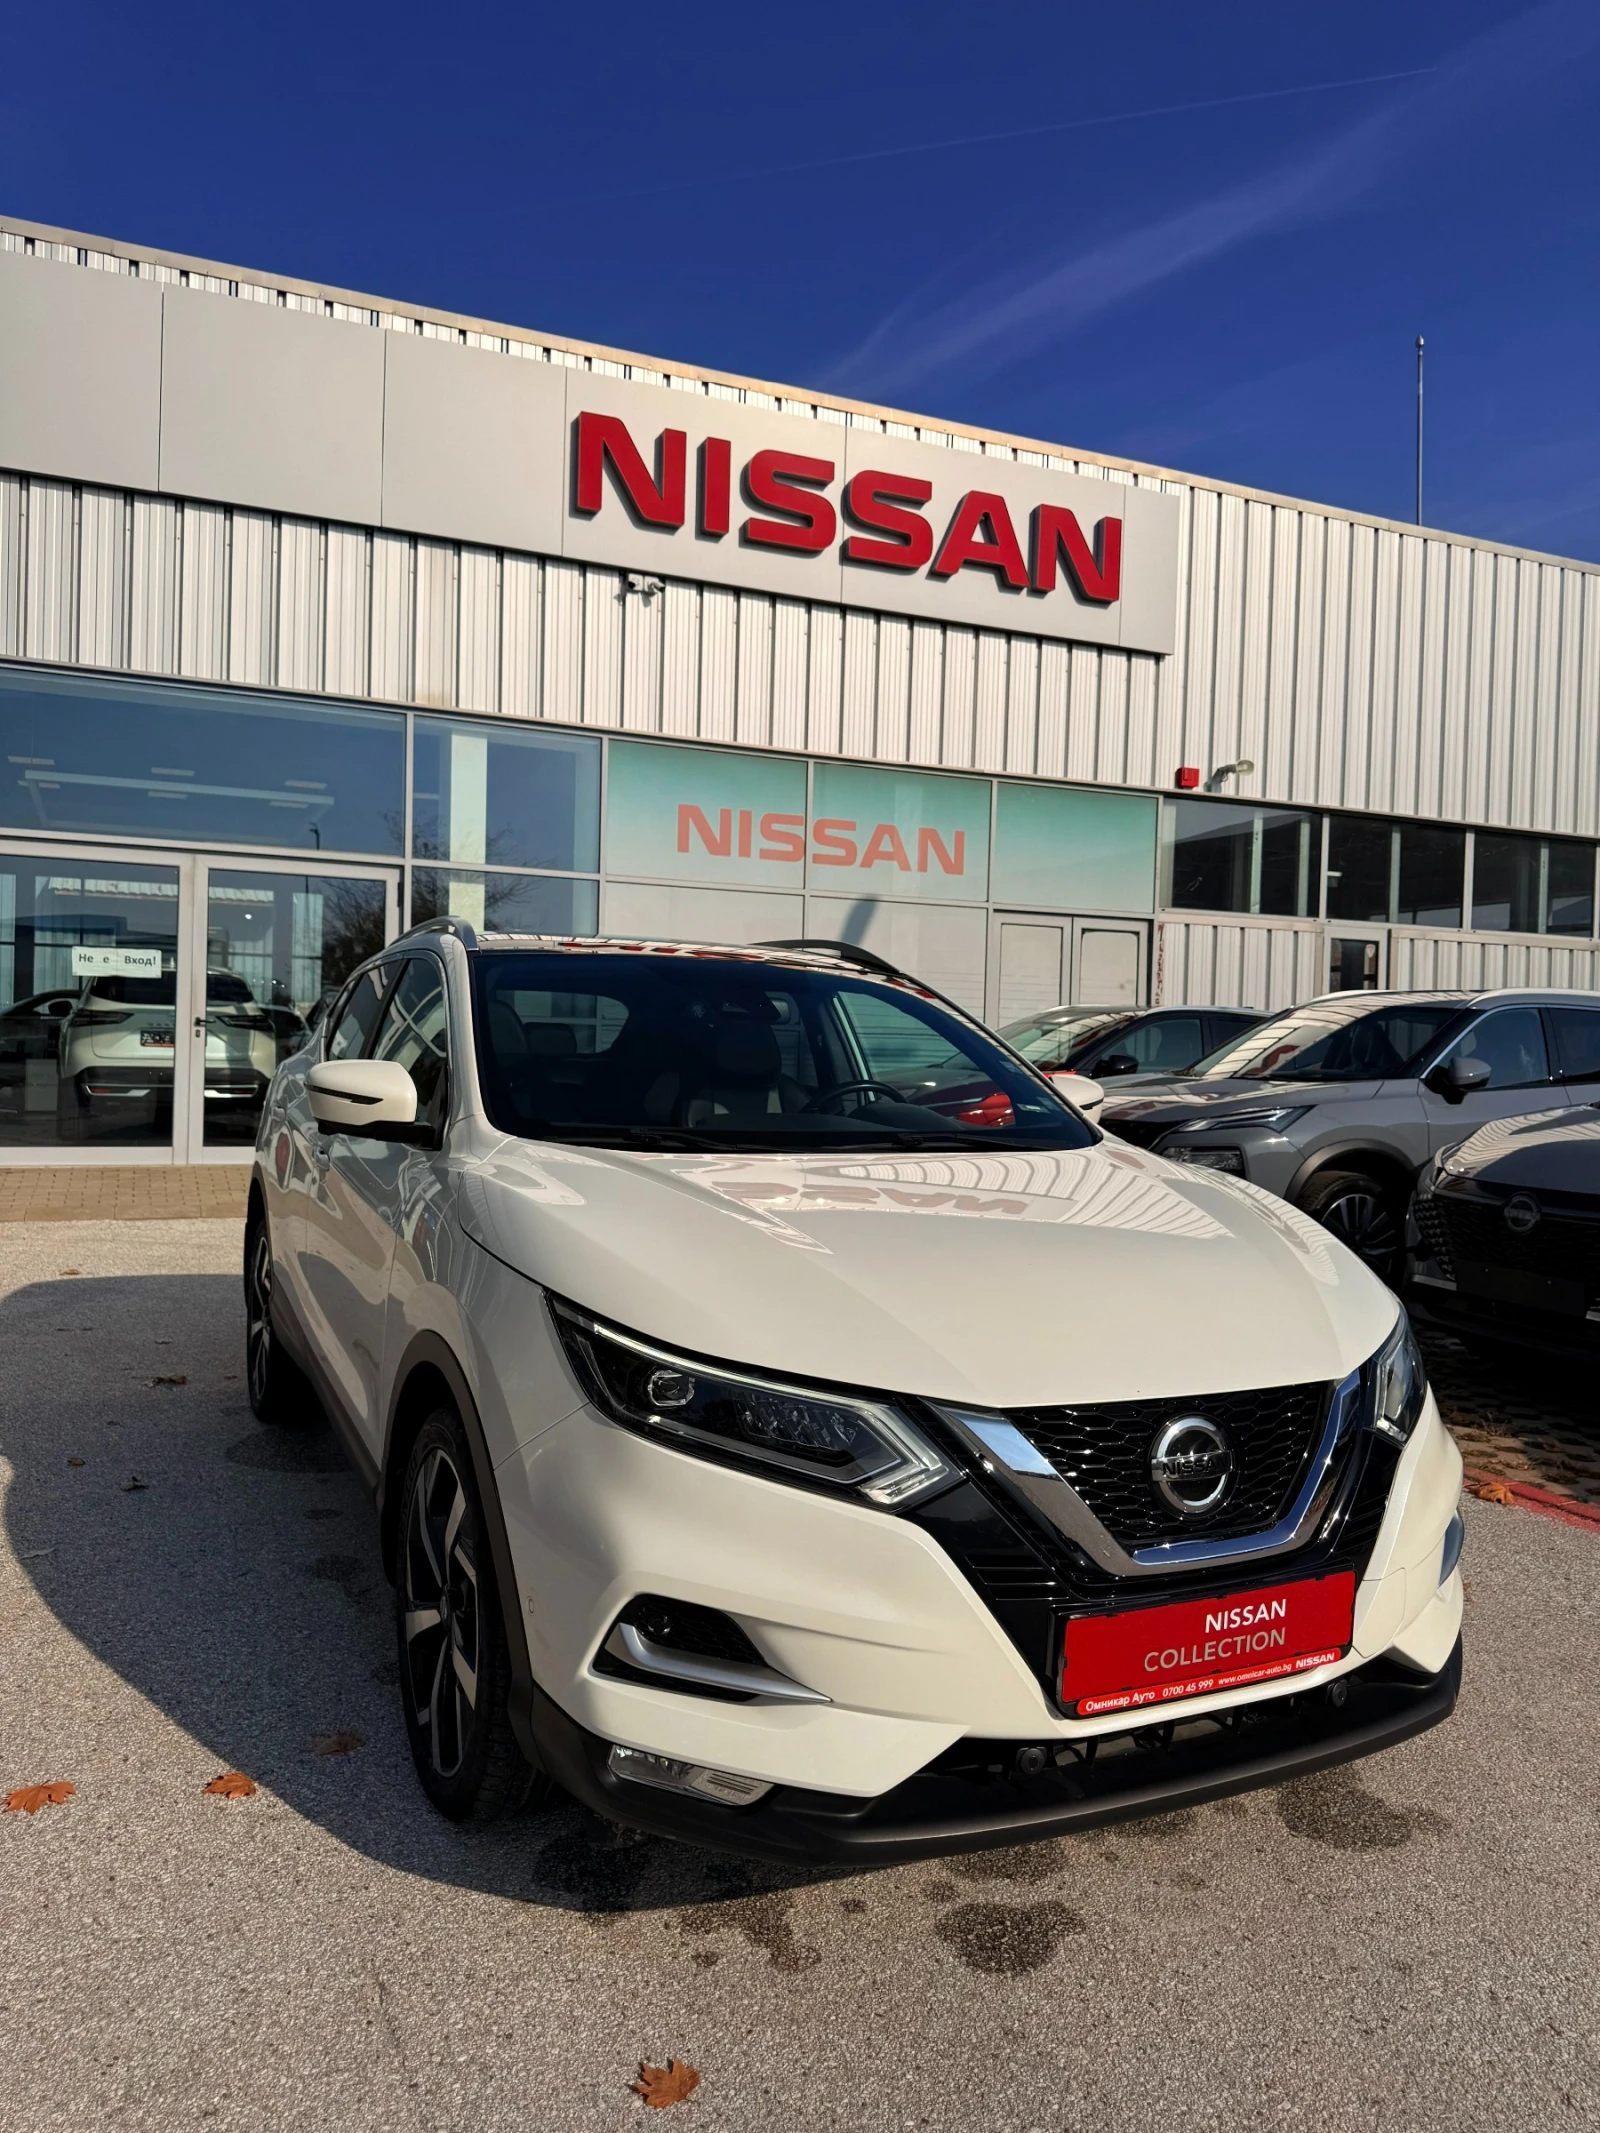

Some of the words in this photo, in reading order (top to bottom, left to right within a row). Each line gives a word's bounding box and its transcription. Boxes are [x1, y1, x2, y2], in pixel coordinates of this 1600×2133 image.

[573, 411, 1122, 604] NISSAN
[677, 804, 965, 876] NISSAN
[78, 953, 94, 963] Не
[102, 956, 110, 964] е
[124, 955, 156, 967] Вход!
[1205, 1599, 1286, 1633] NISSAN
[1144, 1627, 1286, 1672] COLLECTION
[1085, 1696, 1130, 1712] Омникар
[1131, 1691, 1155, 1704] Ауто
[1162, 1685, 1184, 1697] 0700
[1185, 1684, 1196, 1693] 45
[1198, 1679, 1214, 1692] 999
[1218, 1663, 1292, 1685] www.omnicar-auto.bg
[1295, 1652, 1335, 1669] NISSAN
